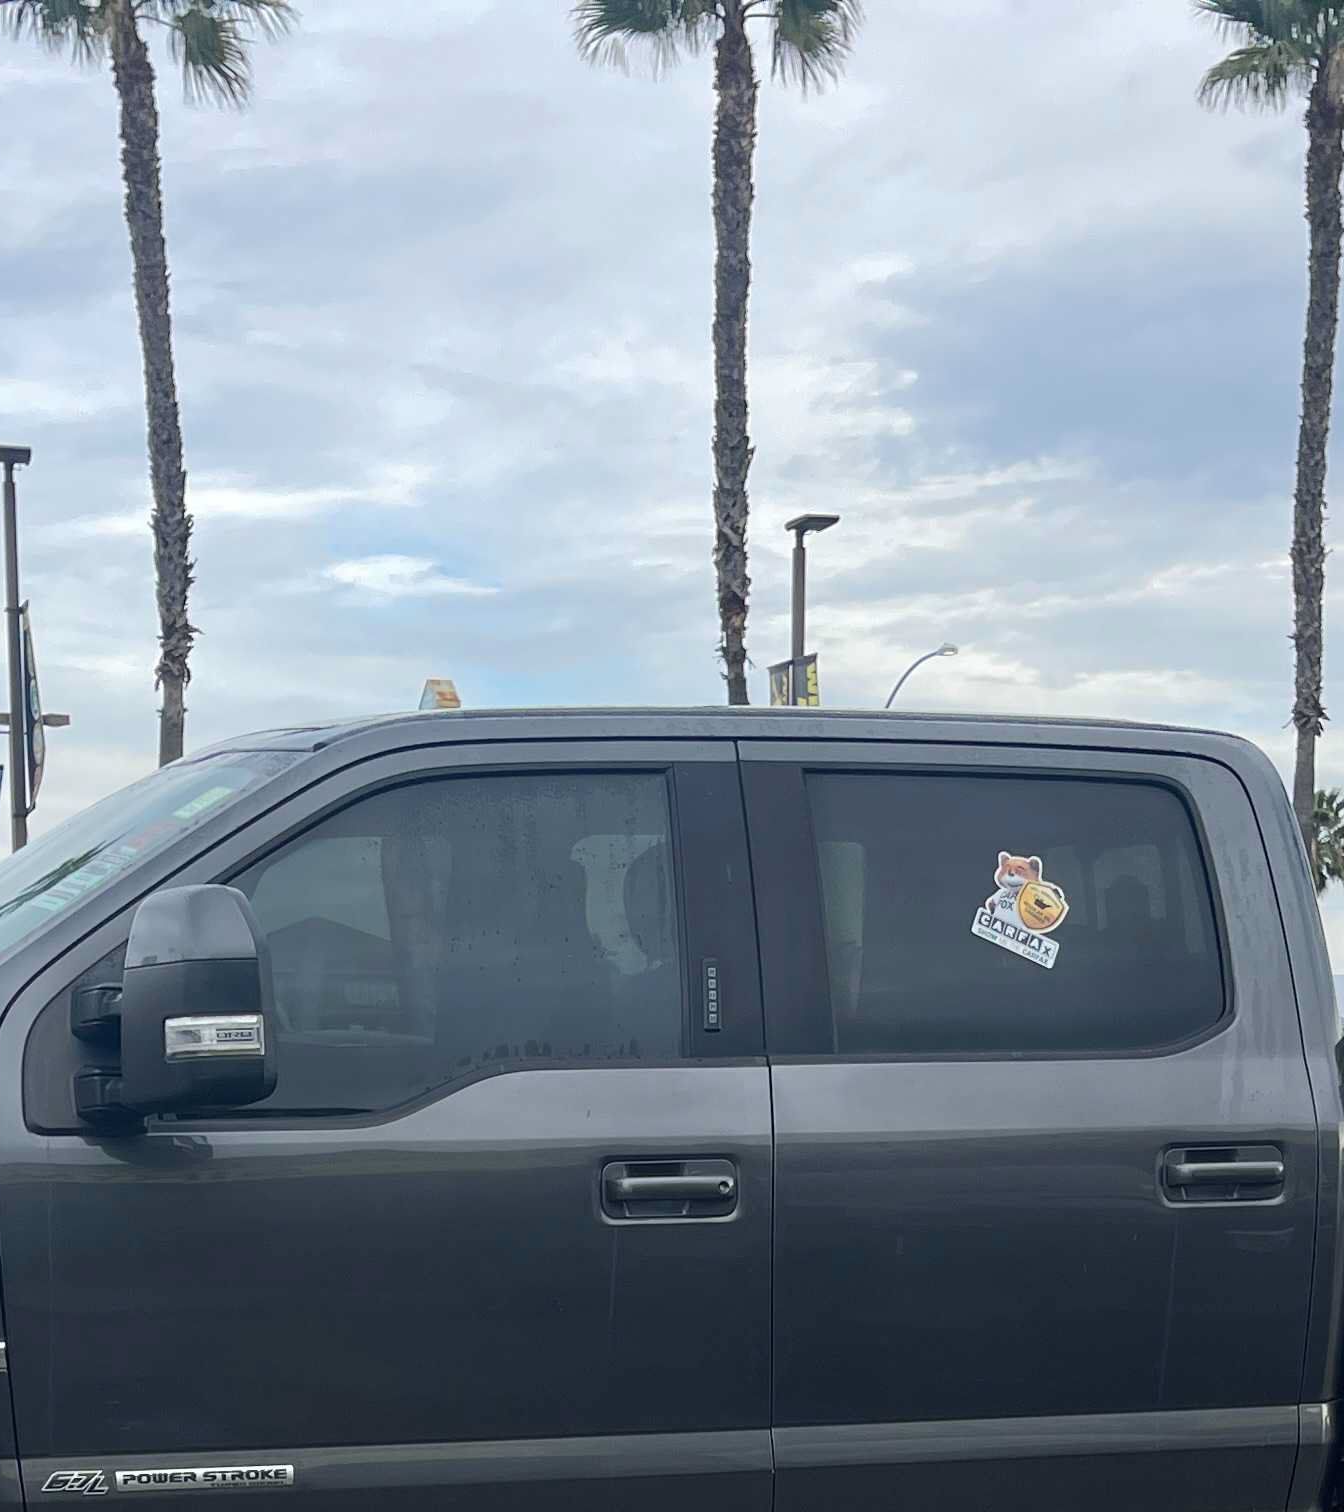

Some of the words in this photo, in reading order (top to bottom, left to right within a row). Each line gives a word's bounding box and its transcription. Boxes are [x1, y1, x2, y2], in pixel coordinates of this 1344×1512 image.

[979, 912, 1052, 958] CARFAX
[122, 1472, 197, 1485] POWER
[202, 1468, 288, 1482] STROKE
